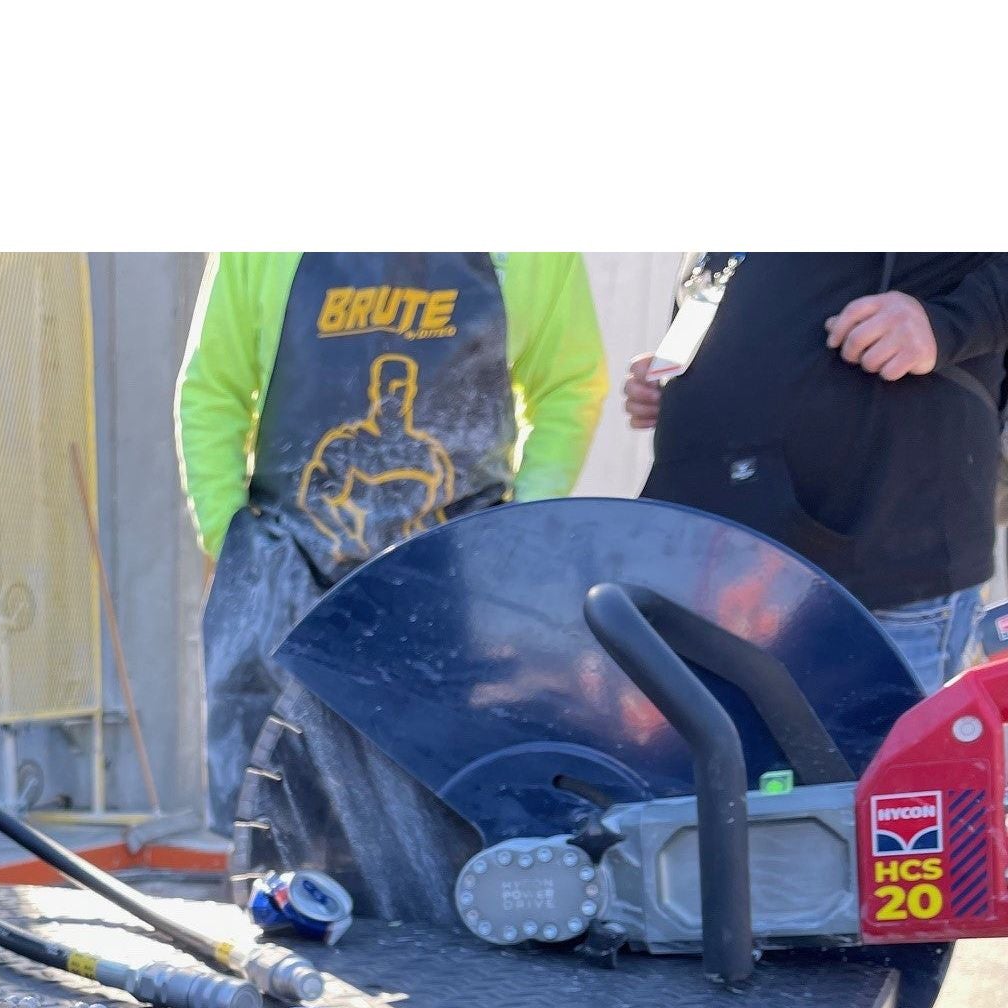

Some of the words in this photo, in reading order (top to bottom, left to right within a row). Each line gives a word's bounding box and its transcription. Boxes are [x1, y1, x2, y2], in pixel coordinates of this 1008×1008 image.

[317, 285, 459, 334] BRUTE
[877, 805, 936, 821] HYCON
[874, 858, 943, 883] HCS
[873, 883, 943, 921] 20
